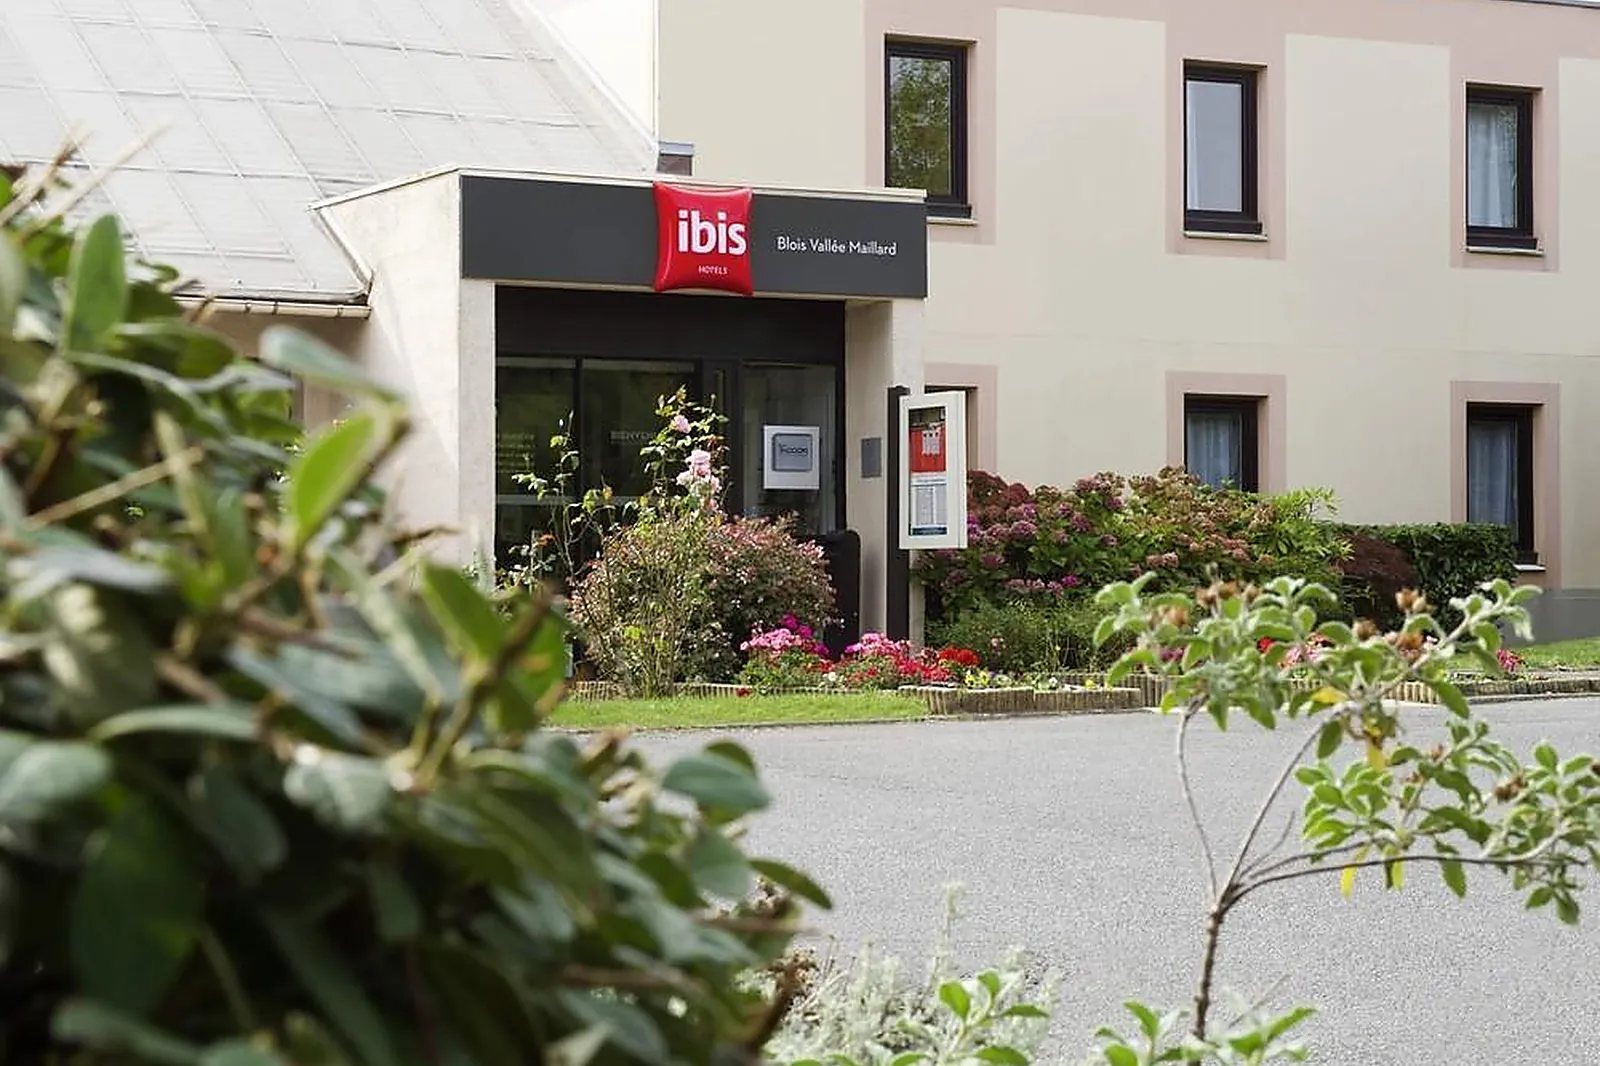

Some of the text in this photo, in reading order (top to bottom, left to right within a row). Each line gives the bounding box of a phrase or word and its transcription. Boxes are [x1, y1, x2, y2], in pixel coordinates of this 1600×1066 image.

[678, 209, 747, 256] ibis
[777, 236, 897, 256] Blois Vallée Maillard
[698, 265, 728, 275] HOTELS
